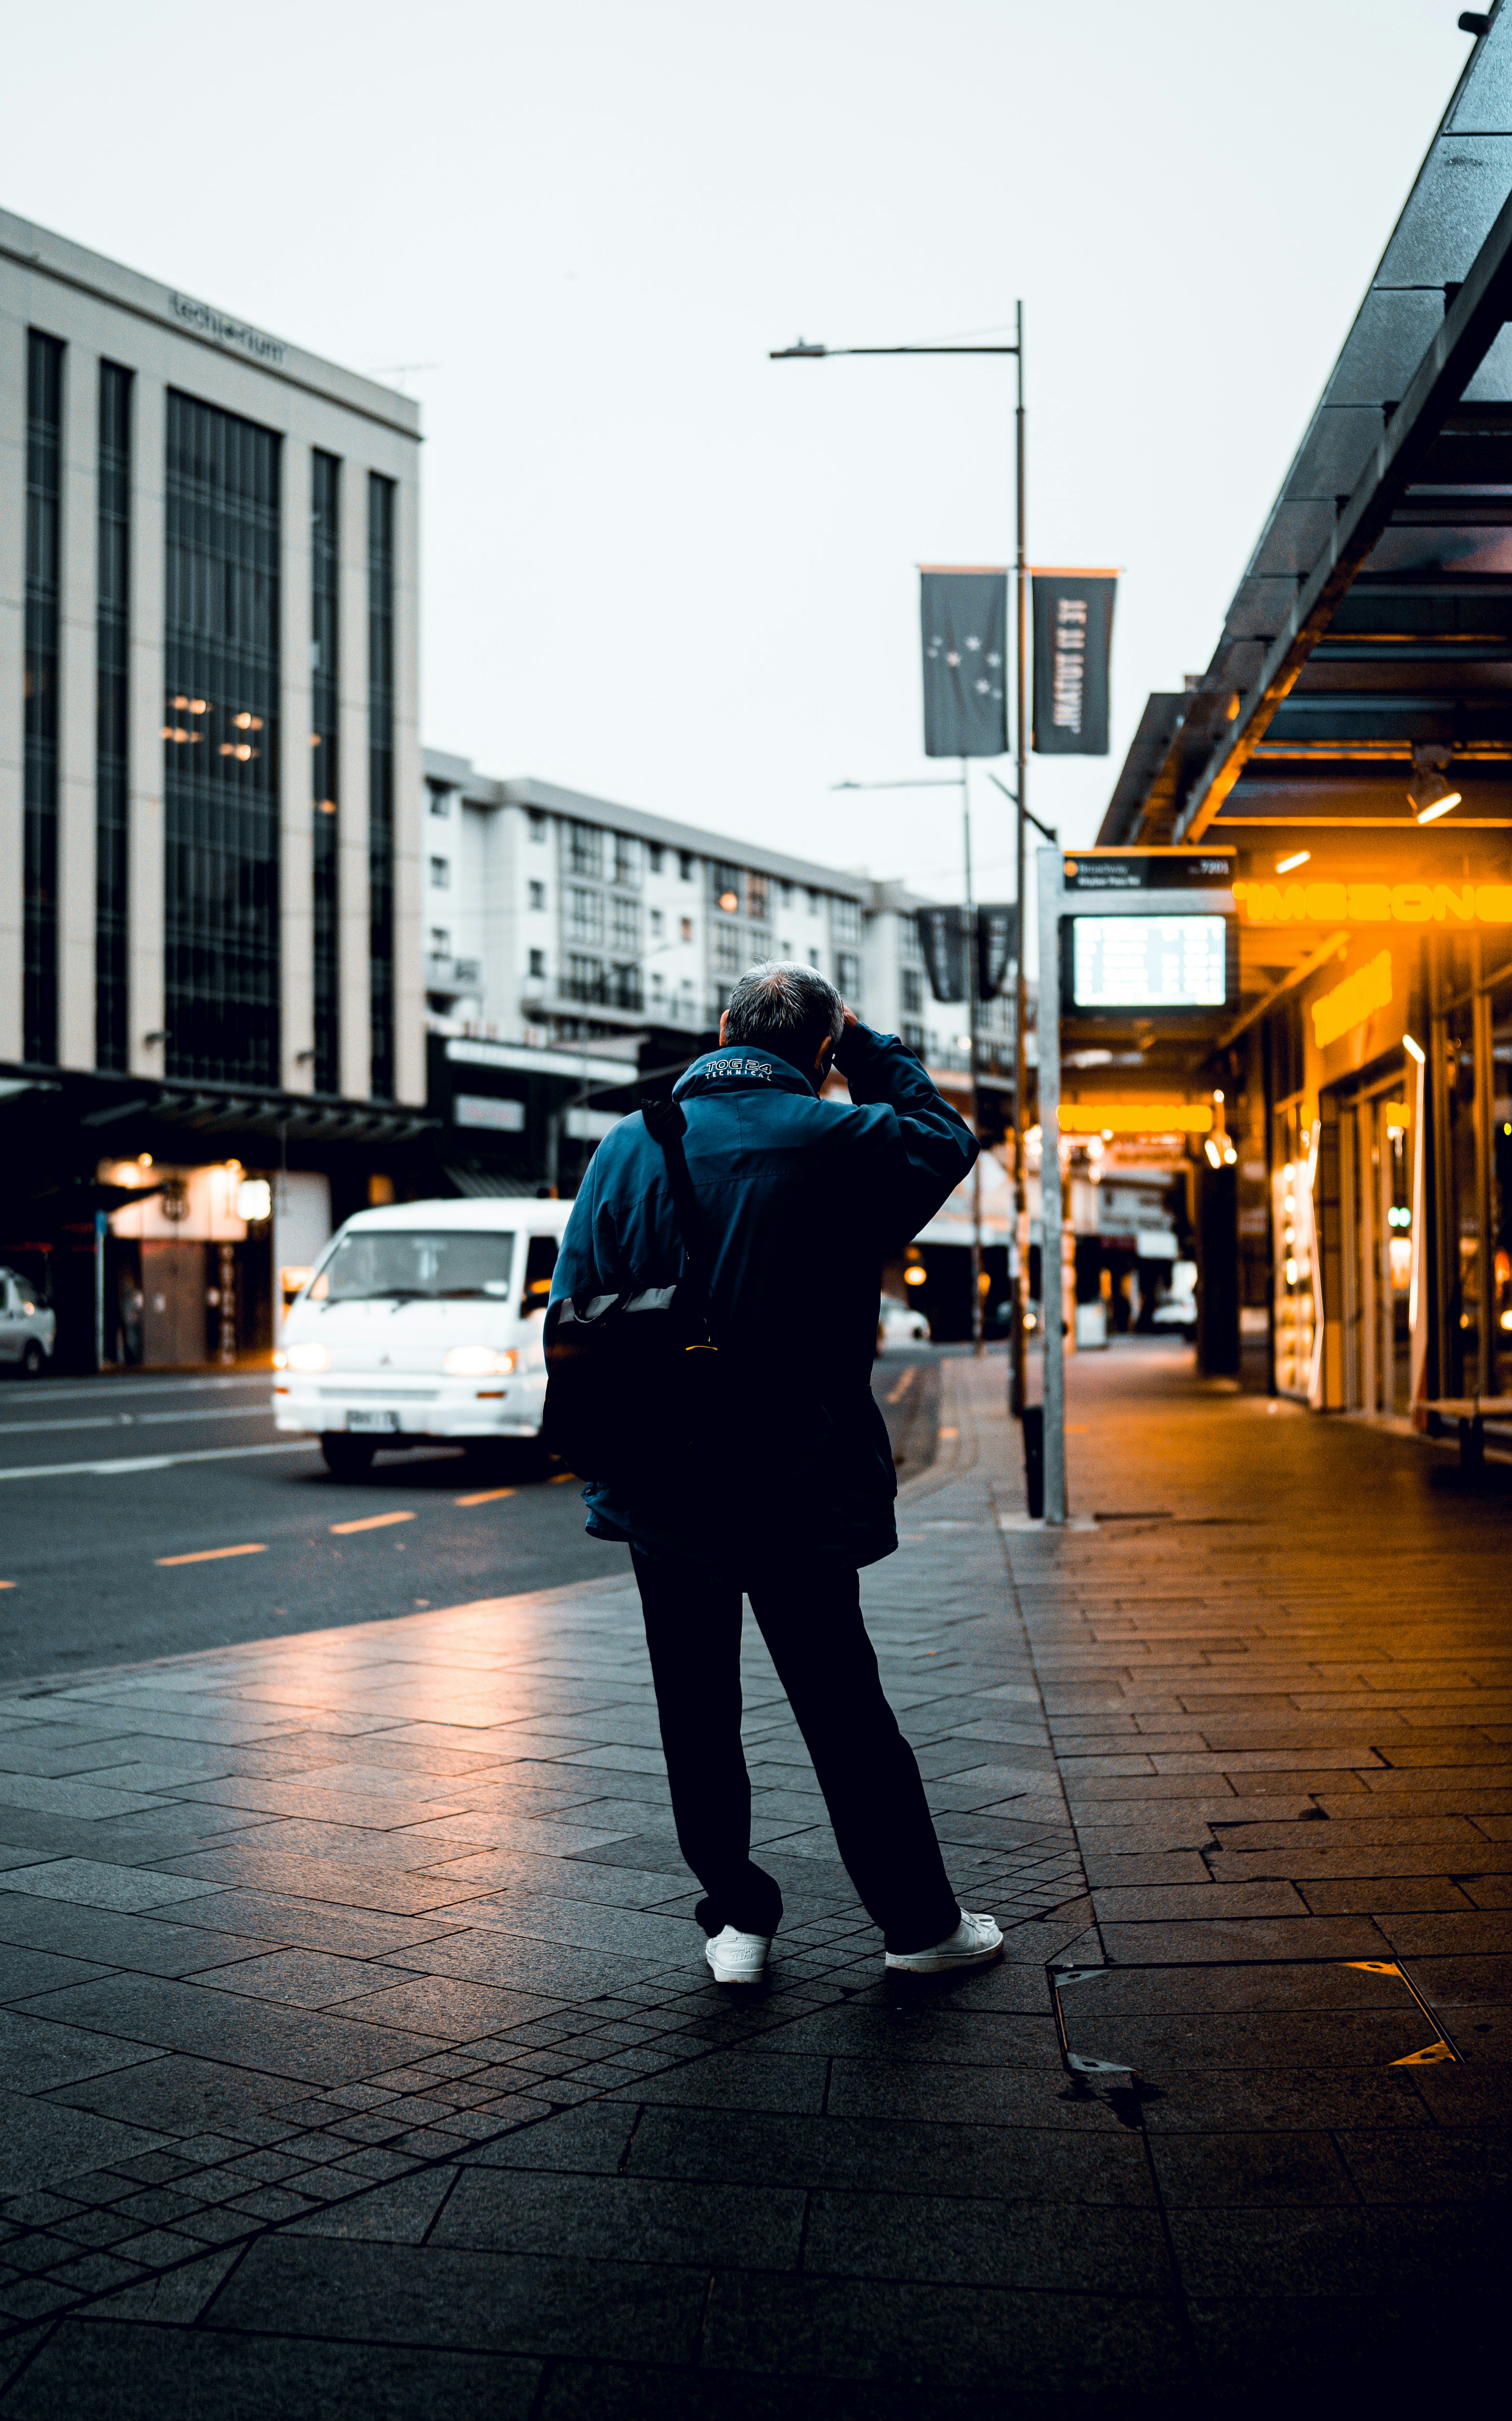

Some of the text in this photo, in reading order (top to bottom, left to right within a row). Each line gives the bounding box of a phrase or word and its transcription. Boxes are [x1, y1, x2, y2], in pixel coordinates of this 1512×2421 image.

[706, 1059, 772, 1074] TOG 24
[705, 1069, 771, 1081] TECHNICAL
